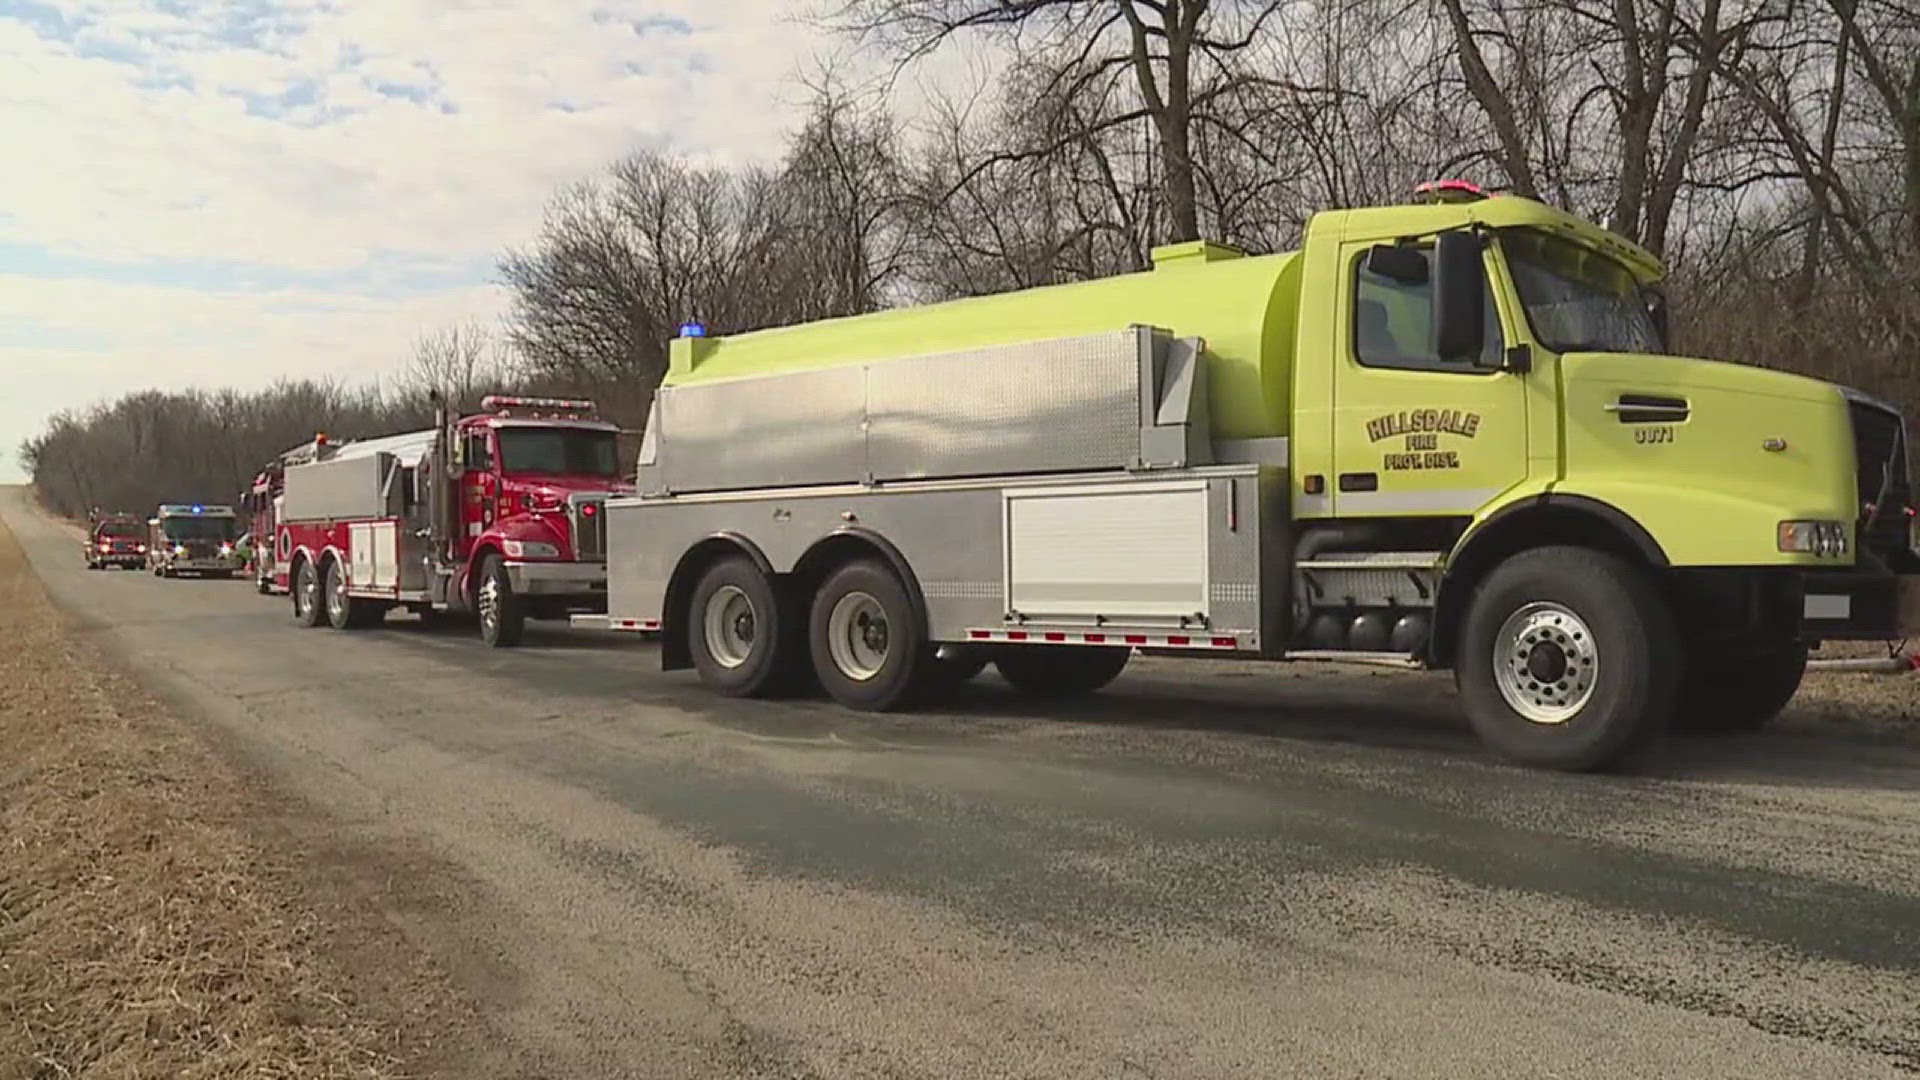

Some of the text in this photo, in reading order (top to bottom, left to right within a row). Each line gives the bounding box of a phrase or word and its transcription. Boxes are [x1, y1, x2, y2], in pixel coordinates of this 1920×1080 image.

[1366, 409, 1480, 442] HILLSDALE
[1406, 434, 1437, 451] FIRE
[1635, 426, 1673, 444] 3071
[1384, 451, 1459, 470] PROT. DIST.
